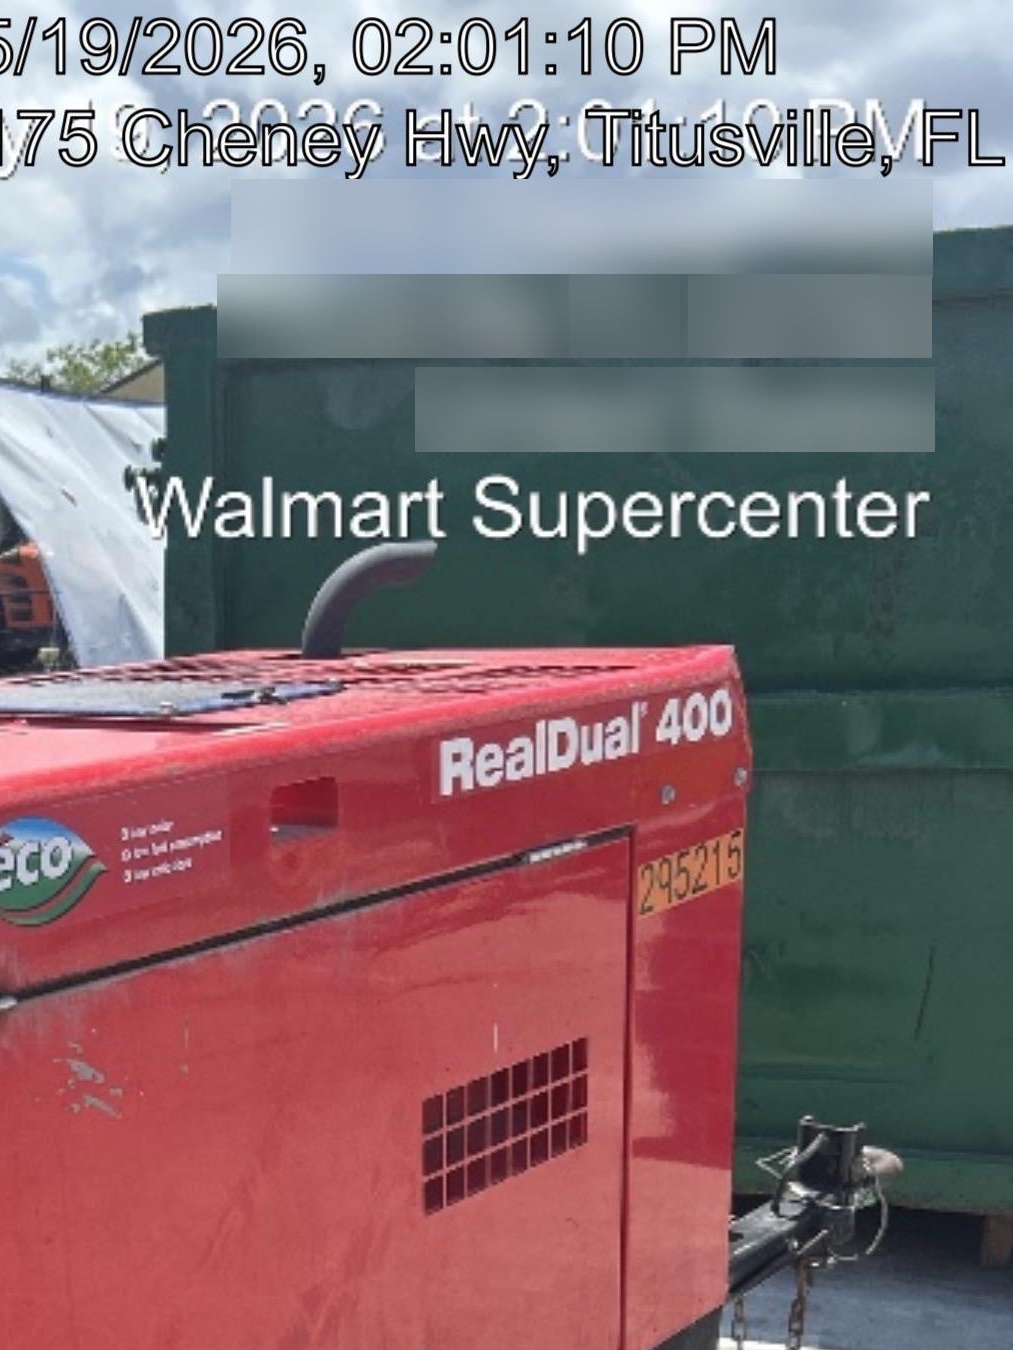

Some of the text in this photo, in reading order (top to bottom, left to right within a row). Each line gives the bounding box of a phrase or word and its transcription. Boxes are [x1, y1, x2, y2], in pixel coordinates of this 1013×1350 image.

[439, 688, 734, 797] RealDual 400
[639, 831, 743, 915] 295215
